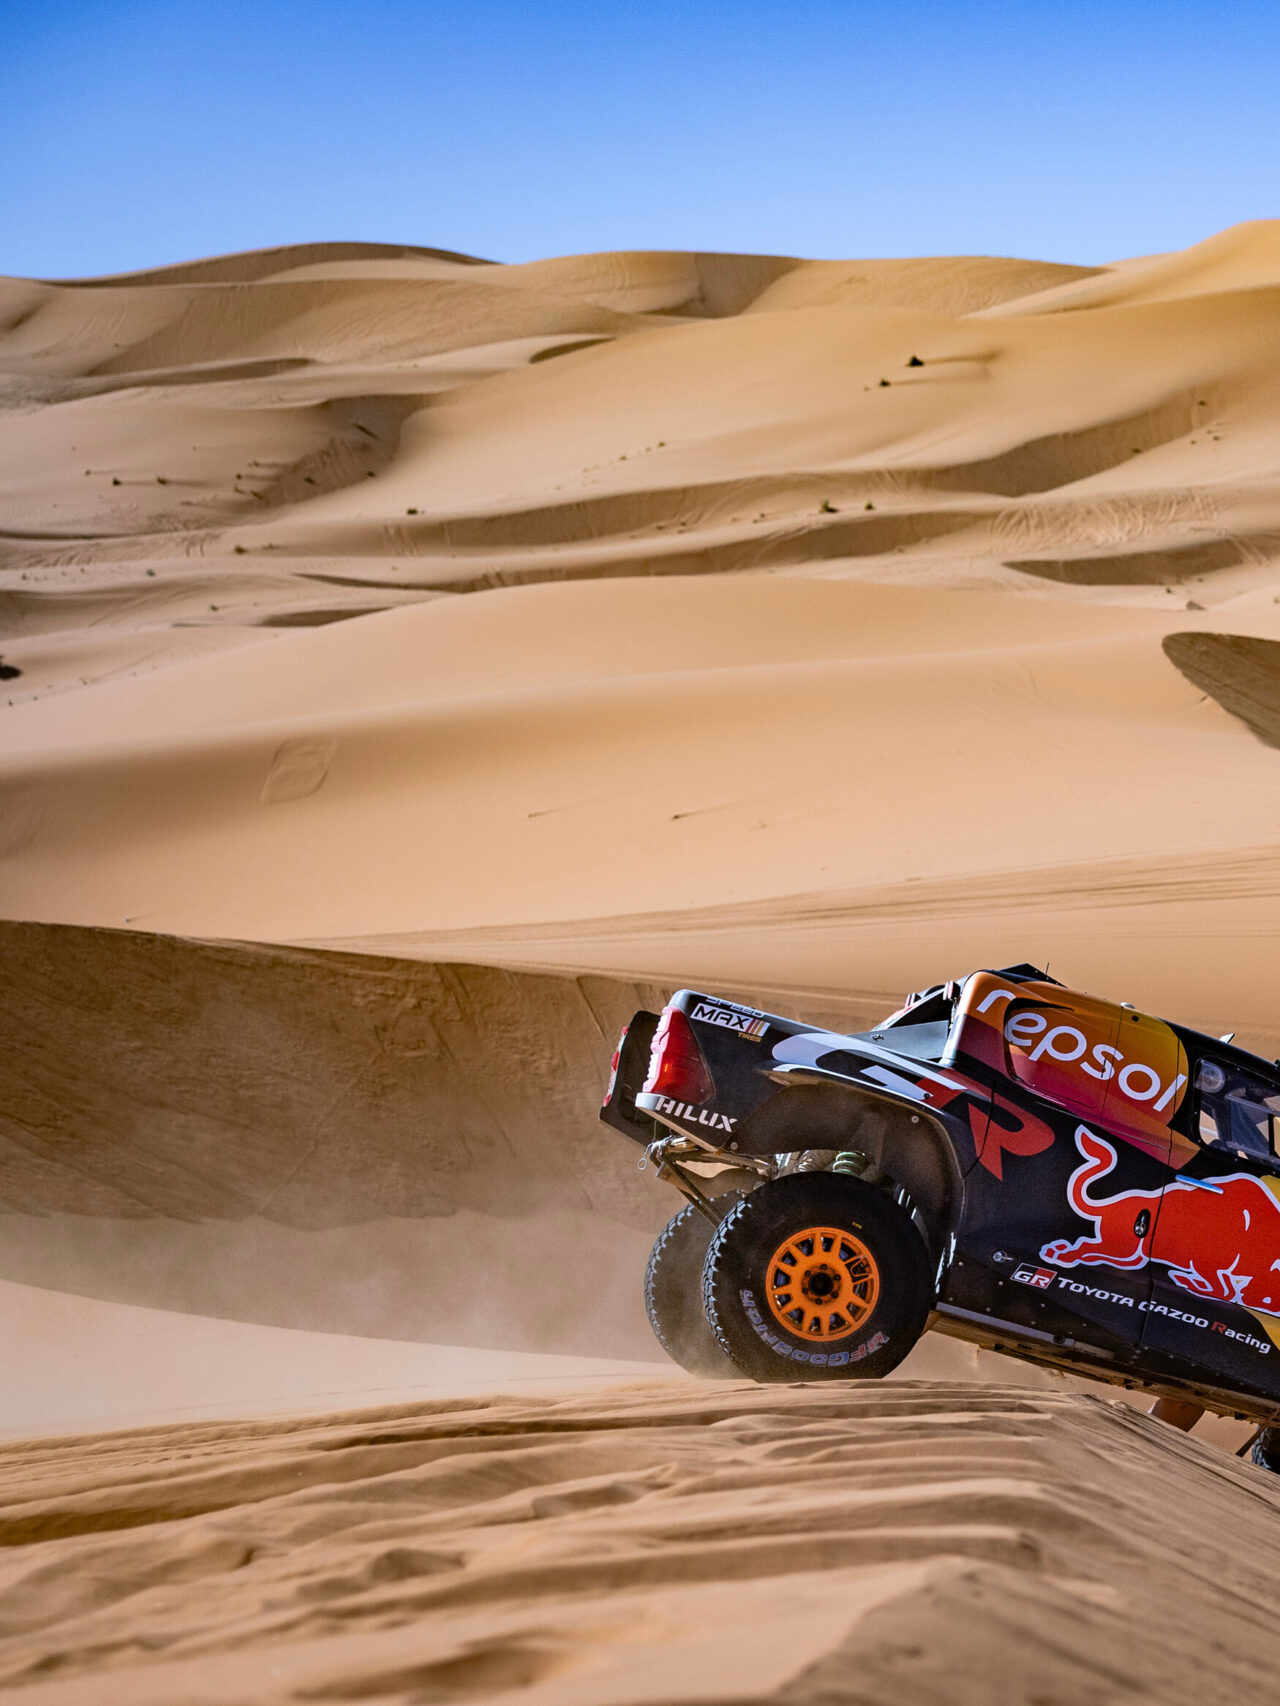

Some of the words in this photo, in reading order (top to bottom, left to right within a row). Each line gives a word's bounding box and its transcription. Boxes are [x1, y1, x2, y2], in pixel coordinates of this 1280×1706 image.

[693, 1005, 750, 1030] MAX
[738, 1032, 762, 1043] TIRES
[976, 989, 1188, 1112] repsol
[655, 1098, 738, 1132] HILUX
[1014, 1269, 1049, 1289] GR
[1057, 1277, 1134, 1308] TOYOTA
[1138, 1300, 1209, 1328] GAZOO
[1211, 1321, 1272, 1354] Racing
